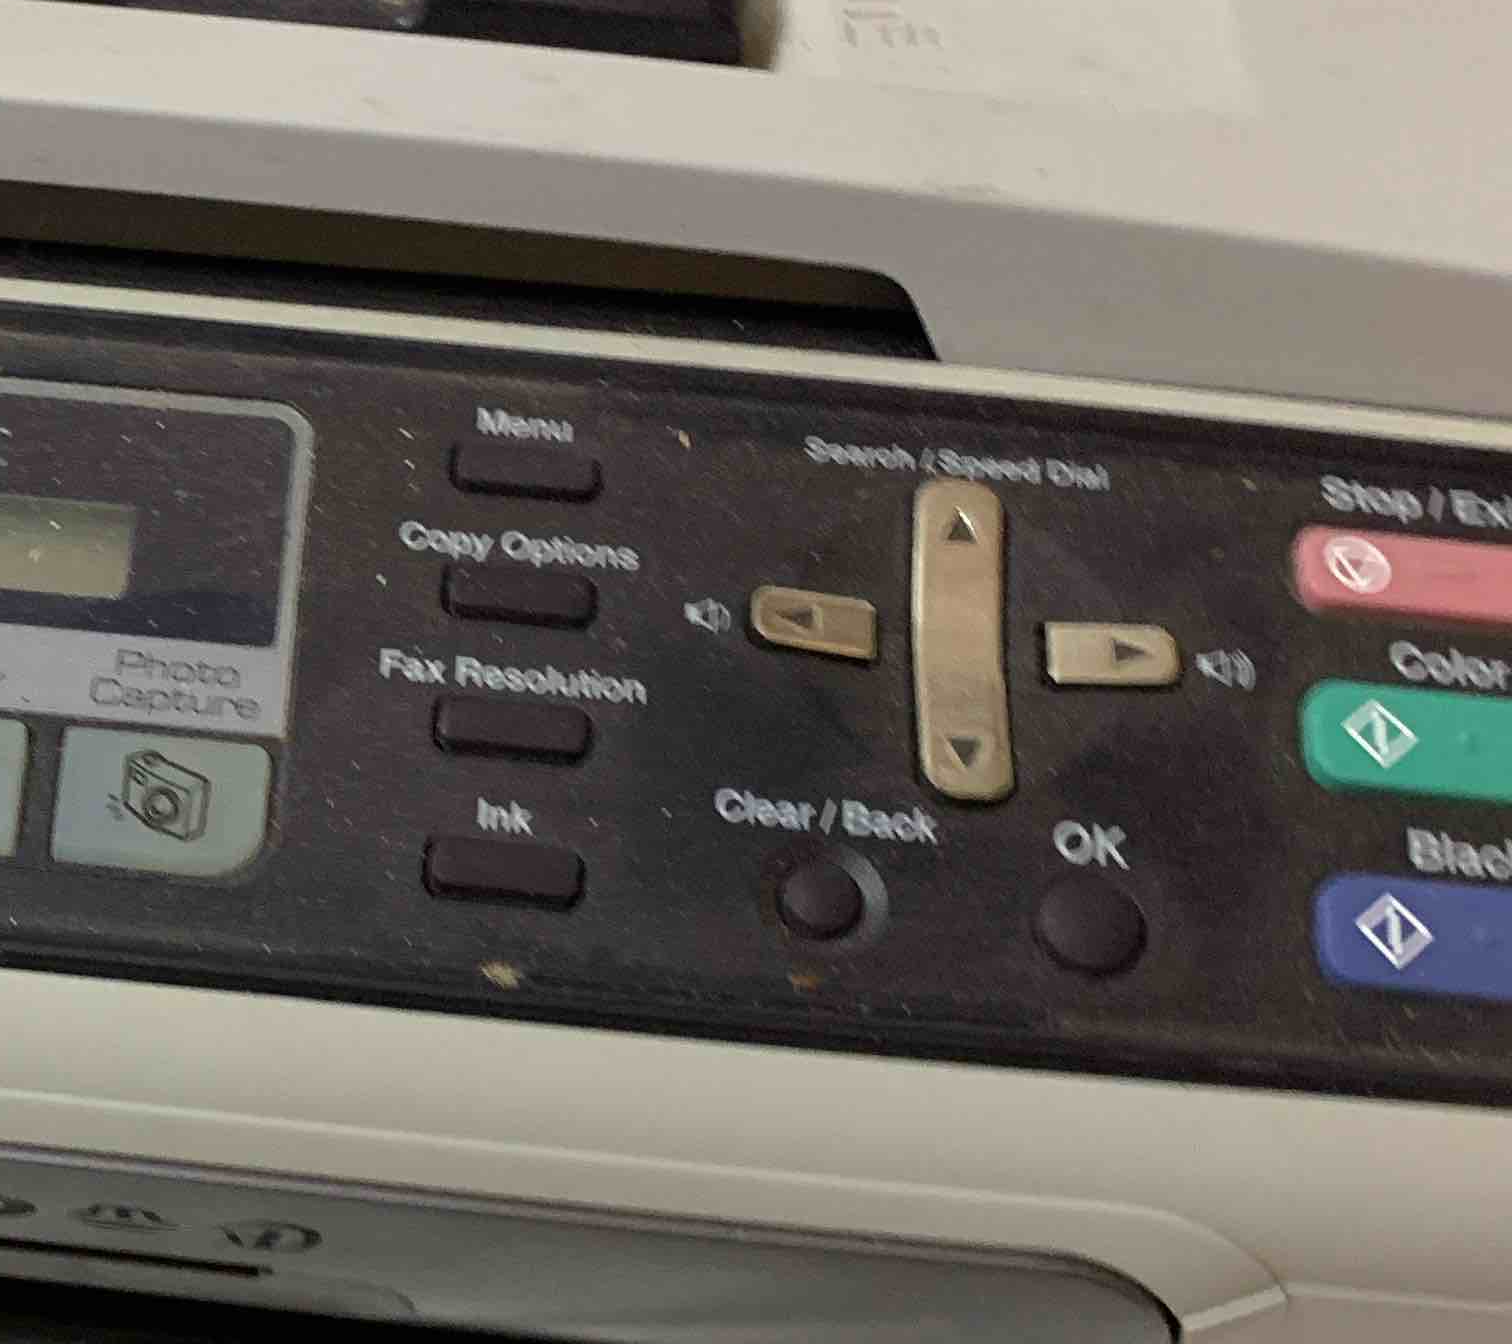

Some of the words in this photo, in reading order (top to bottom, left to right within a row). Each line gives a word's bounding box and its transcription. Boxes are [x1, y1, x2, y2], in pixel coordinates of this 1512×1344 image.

[476, 406, 574, 443] Menu
[398, 520, 494, 562] Copy
[500, 530, 640, 571] Options
[114, 648, 241, 689] Photo
[379, 647, 447, 686] Fax
[454, 655, 648, 705] Resolution
[1390, 640, 1512, 691] Color
[89, 678, 262, 720] Capture
[476, 797, 534, 837] Ink
[1052, 819, 1130, 871] OK
[1406, 826, 1512, 880] Blac
